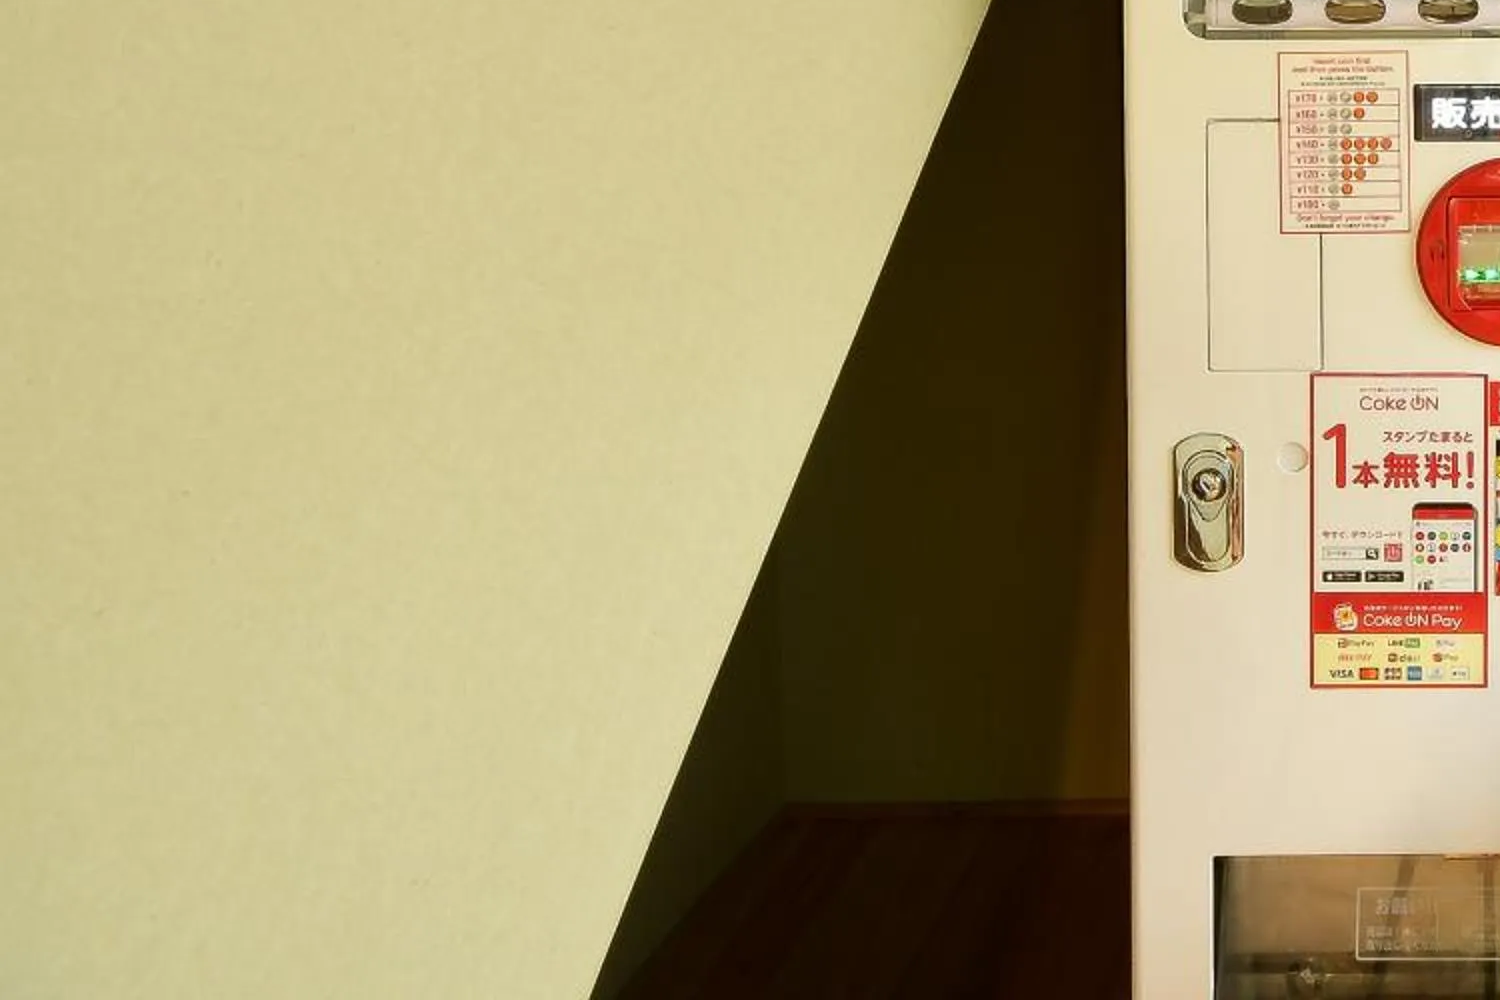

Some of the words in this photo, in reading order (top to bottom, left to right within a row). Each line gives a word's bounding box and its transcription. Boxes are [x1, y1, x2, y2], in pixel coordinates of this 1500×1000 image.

[1359, 396, 1407, 411] Coke
[1410, 395, 1439, 411] ON
[1382, 430, 1474, 443] スタンプたまると
[1363, 614, 1402, 627] Coke
[1405, 612, 1429, 627] ON
[1432, 614, 1463, 630] Pay
[1329, 669, 1354, 679] VISA
